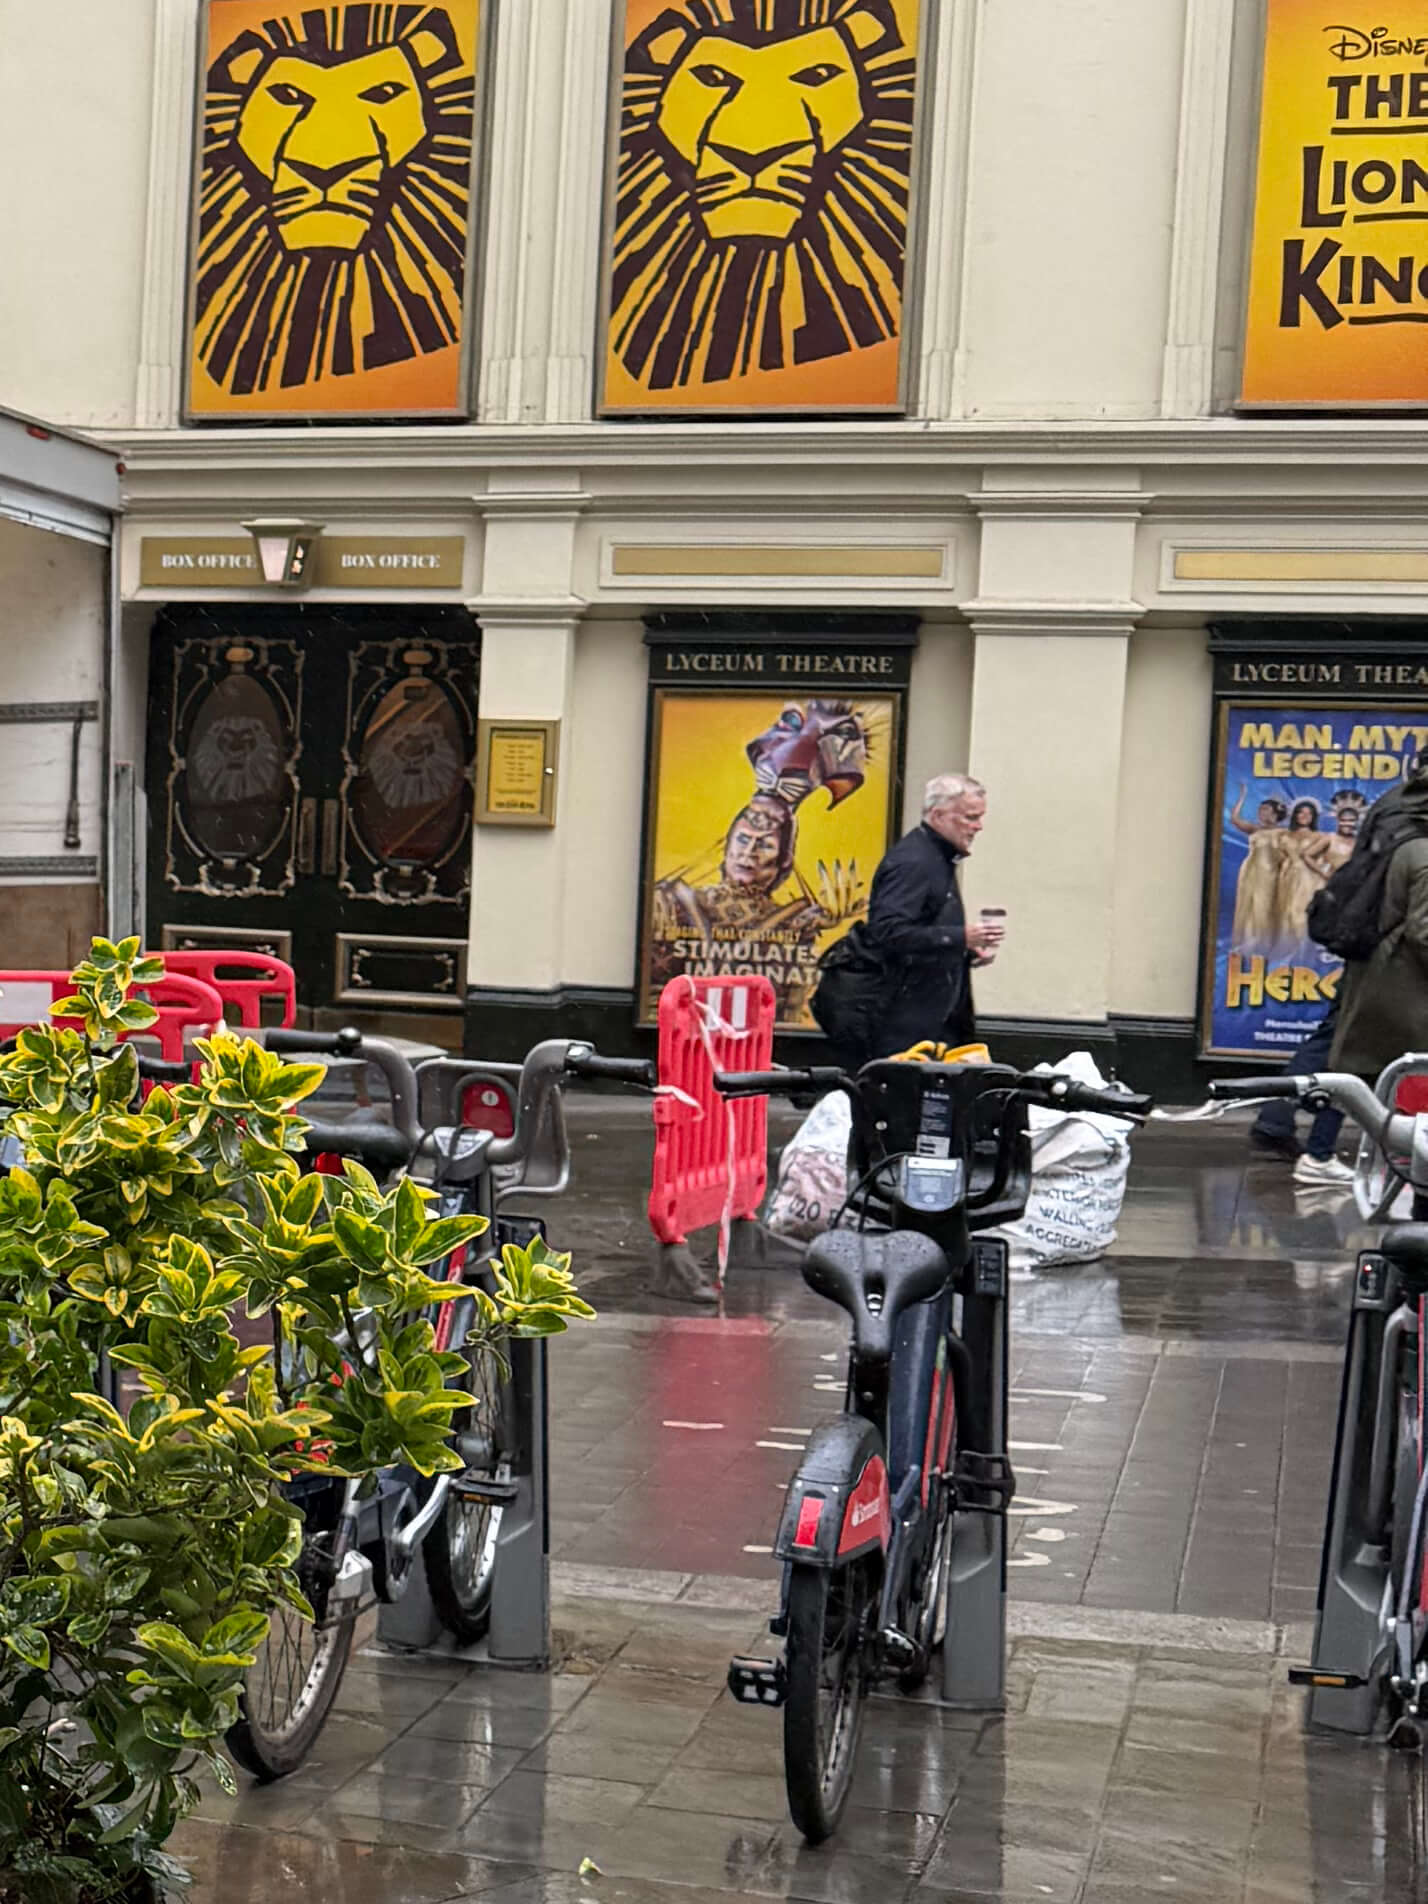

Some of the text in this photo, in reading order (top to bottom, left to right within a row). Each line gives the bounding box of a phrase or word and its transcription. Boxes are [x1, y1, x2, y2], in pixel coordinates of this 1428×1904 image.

[1322, 25, 1428, 67] Disne
[1327, 72, 1428, 120] THE
[1301, 145, 1428, 228] LION
[1279, 237, 1428, 330] KIN
[161, 554, 256, 569] BOX OFFICE
[340, 554, 441, 569] BOX OFFICE
[666, 653, 894, 674] LYCEUM THEATRE
[1233, 663, 1428, 685] LYCEUM THEA
[1239, 722, 1428, 753] MAN. MYT
[673, 940, 820, 964] STIMULATES
[1226, 953, 1345, 1008] HERC
